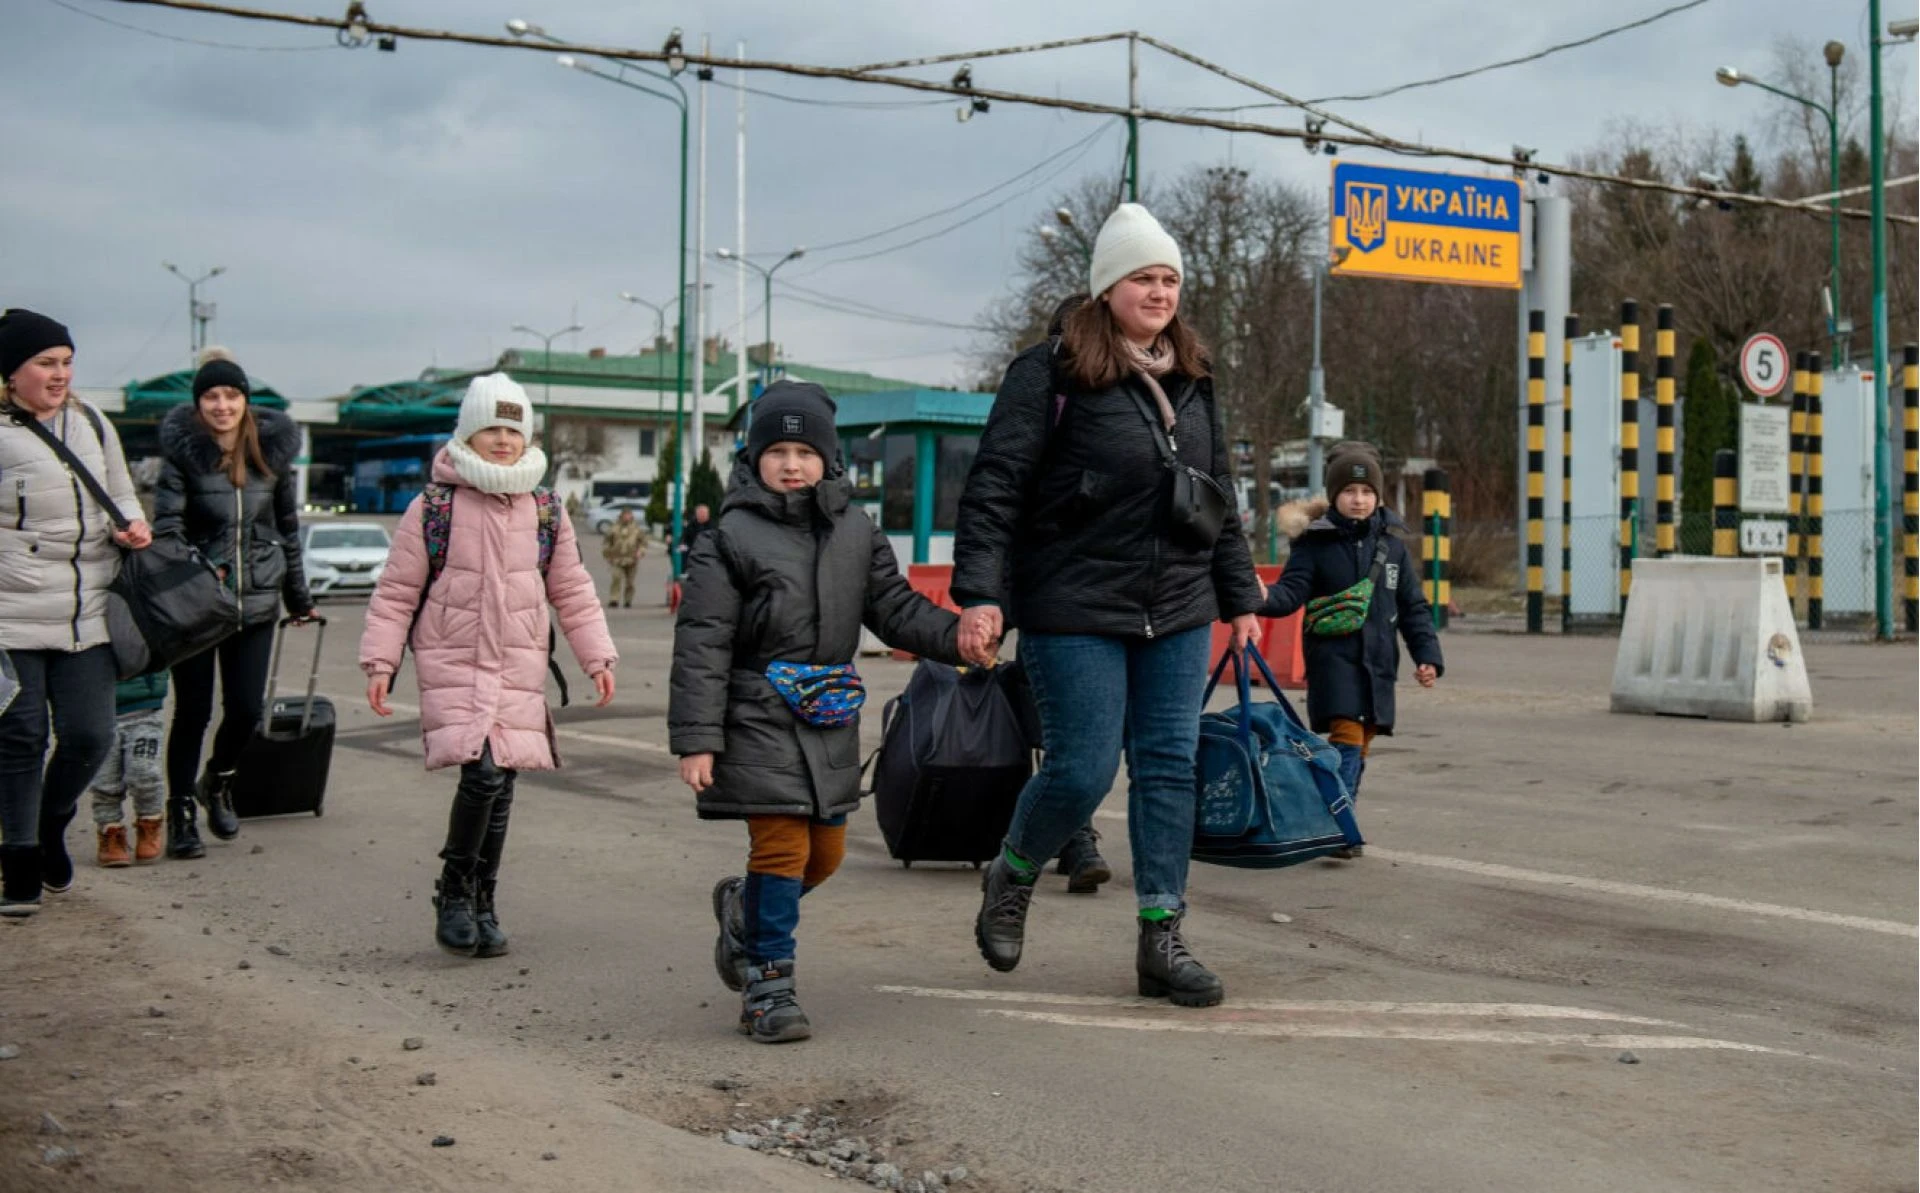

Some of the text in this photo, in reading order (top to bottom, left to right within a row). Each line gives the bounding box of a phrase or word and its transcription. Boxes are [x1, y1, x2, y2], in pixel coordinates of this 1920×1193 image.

[1396, 186, 1509, 220] УКРАЇНА
[1396, 237, 1502, 267] UKRAINE
[1757, 350, 1772, 380] 5
